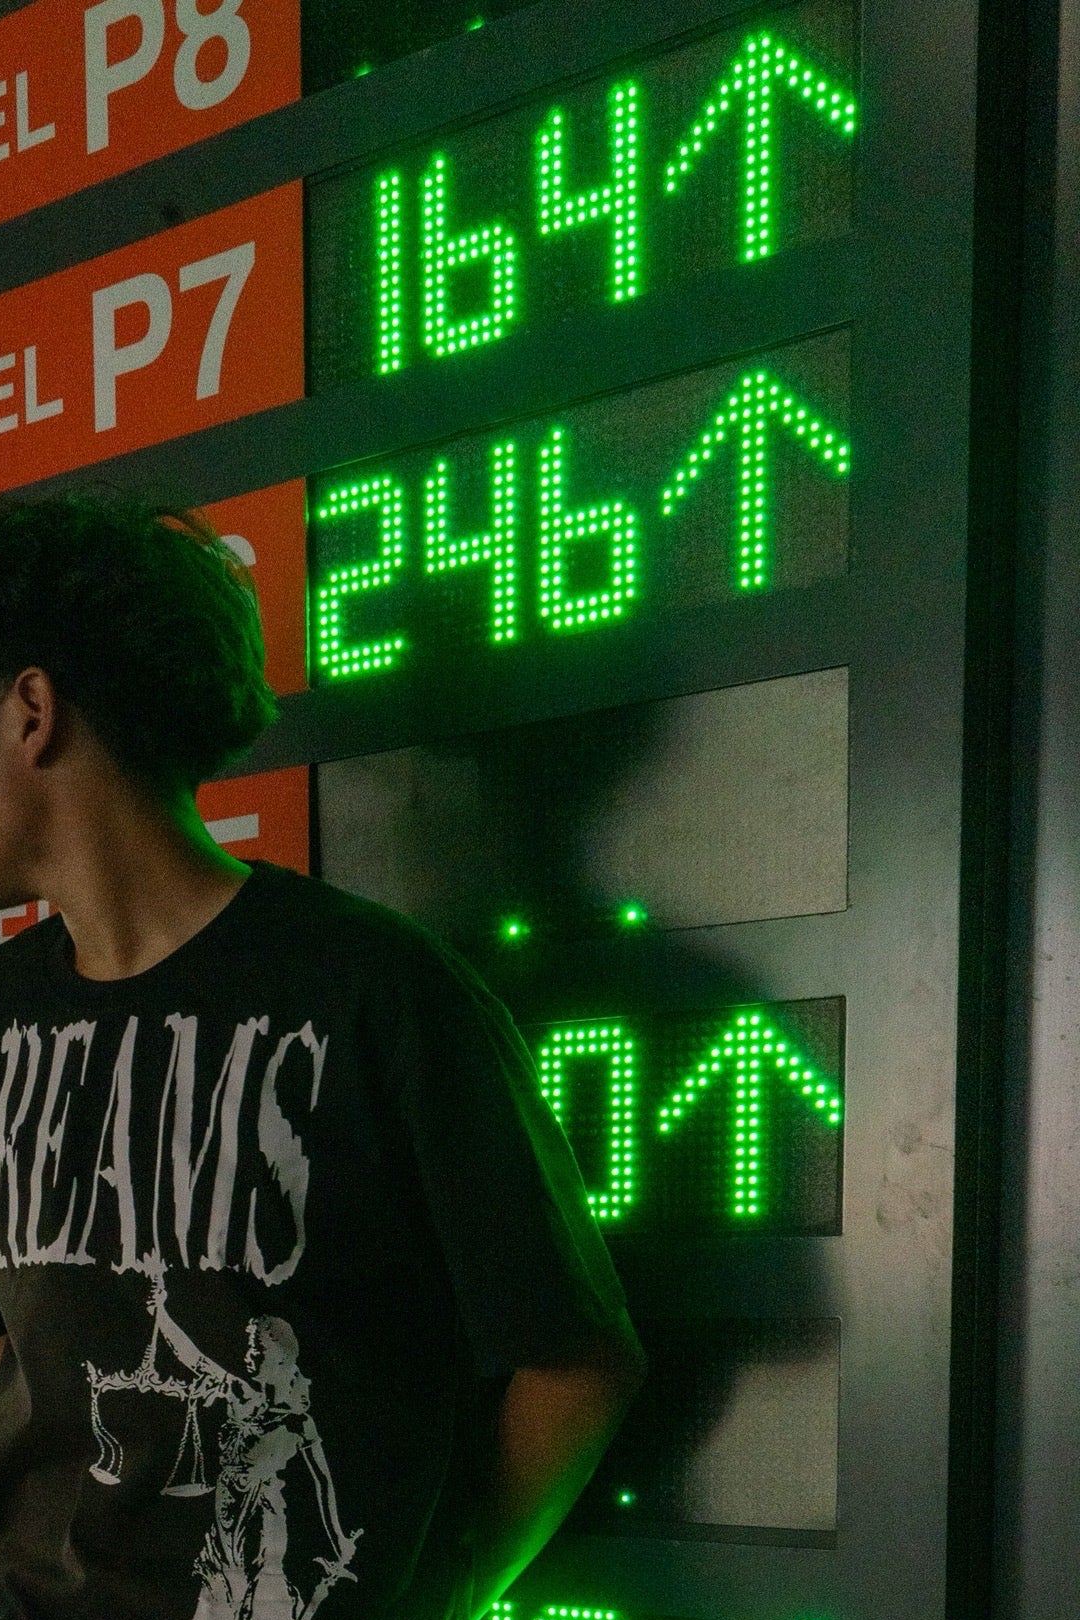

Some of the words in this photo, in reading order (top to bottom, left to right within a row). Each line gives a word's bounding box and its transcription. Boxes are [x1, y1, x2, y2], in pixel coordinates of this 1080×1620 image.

[83, 0, 251, 155] P8
[92, 241, 256, 434] P7
[376, 82, 640, 374] 164
[318, 427, 637, 678] 246
